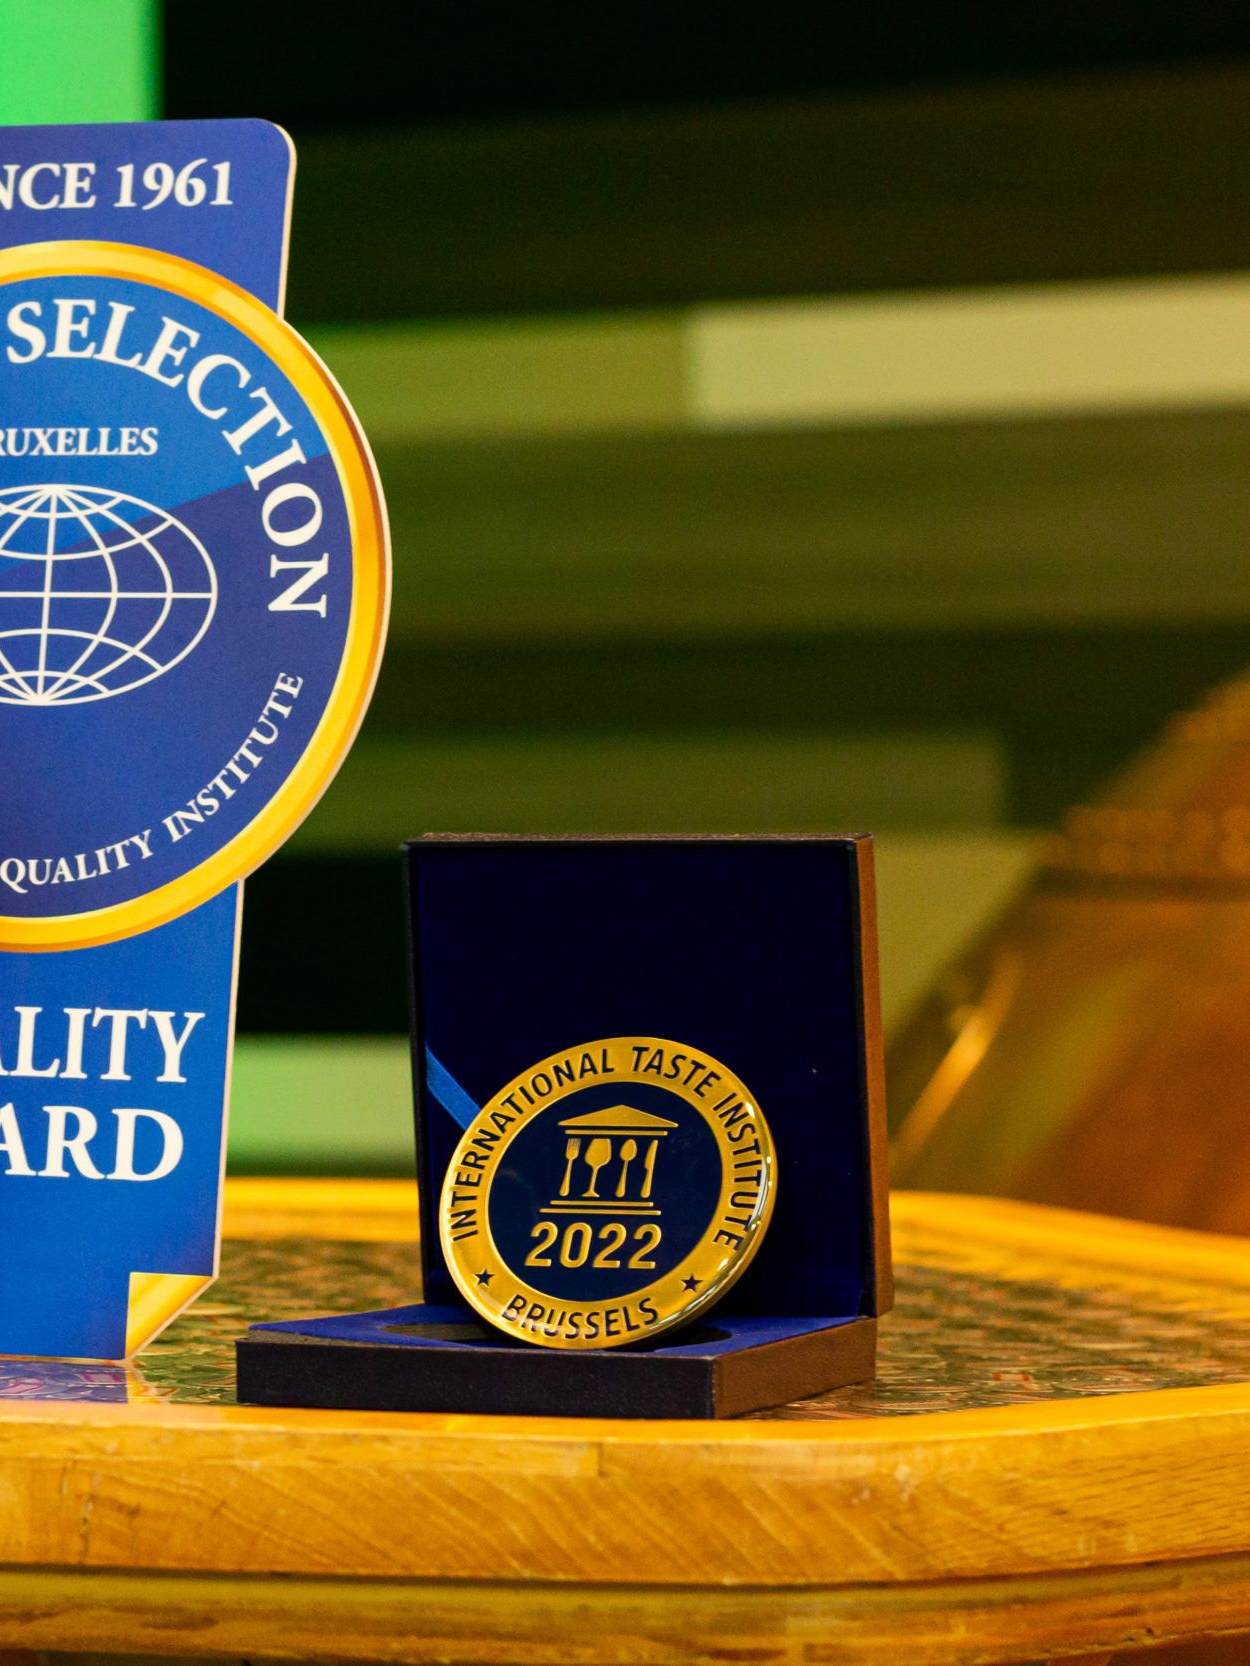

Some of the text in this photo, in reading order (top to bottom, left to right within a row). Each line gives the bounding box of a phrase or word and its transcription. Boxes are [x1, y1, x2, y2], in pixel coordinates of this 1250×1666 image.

[114, 157, 235, 211] 1961
[5, 298, 330, 619] SELECTION
[161, 671, 304, 844] INSTITUTE
[450, 1045, 763, 1251] INTERNATIONAL TASTE INSTITUTE
[524, 1221, 663, 1270] 2022
[501, 1294, 660, 1340] BRUSSELS
